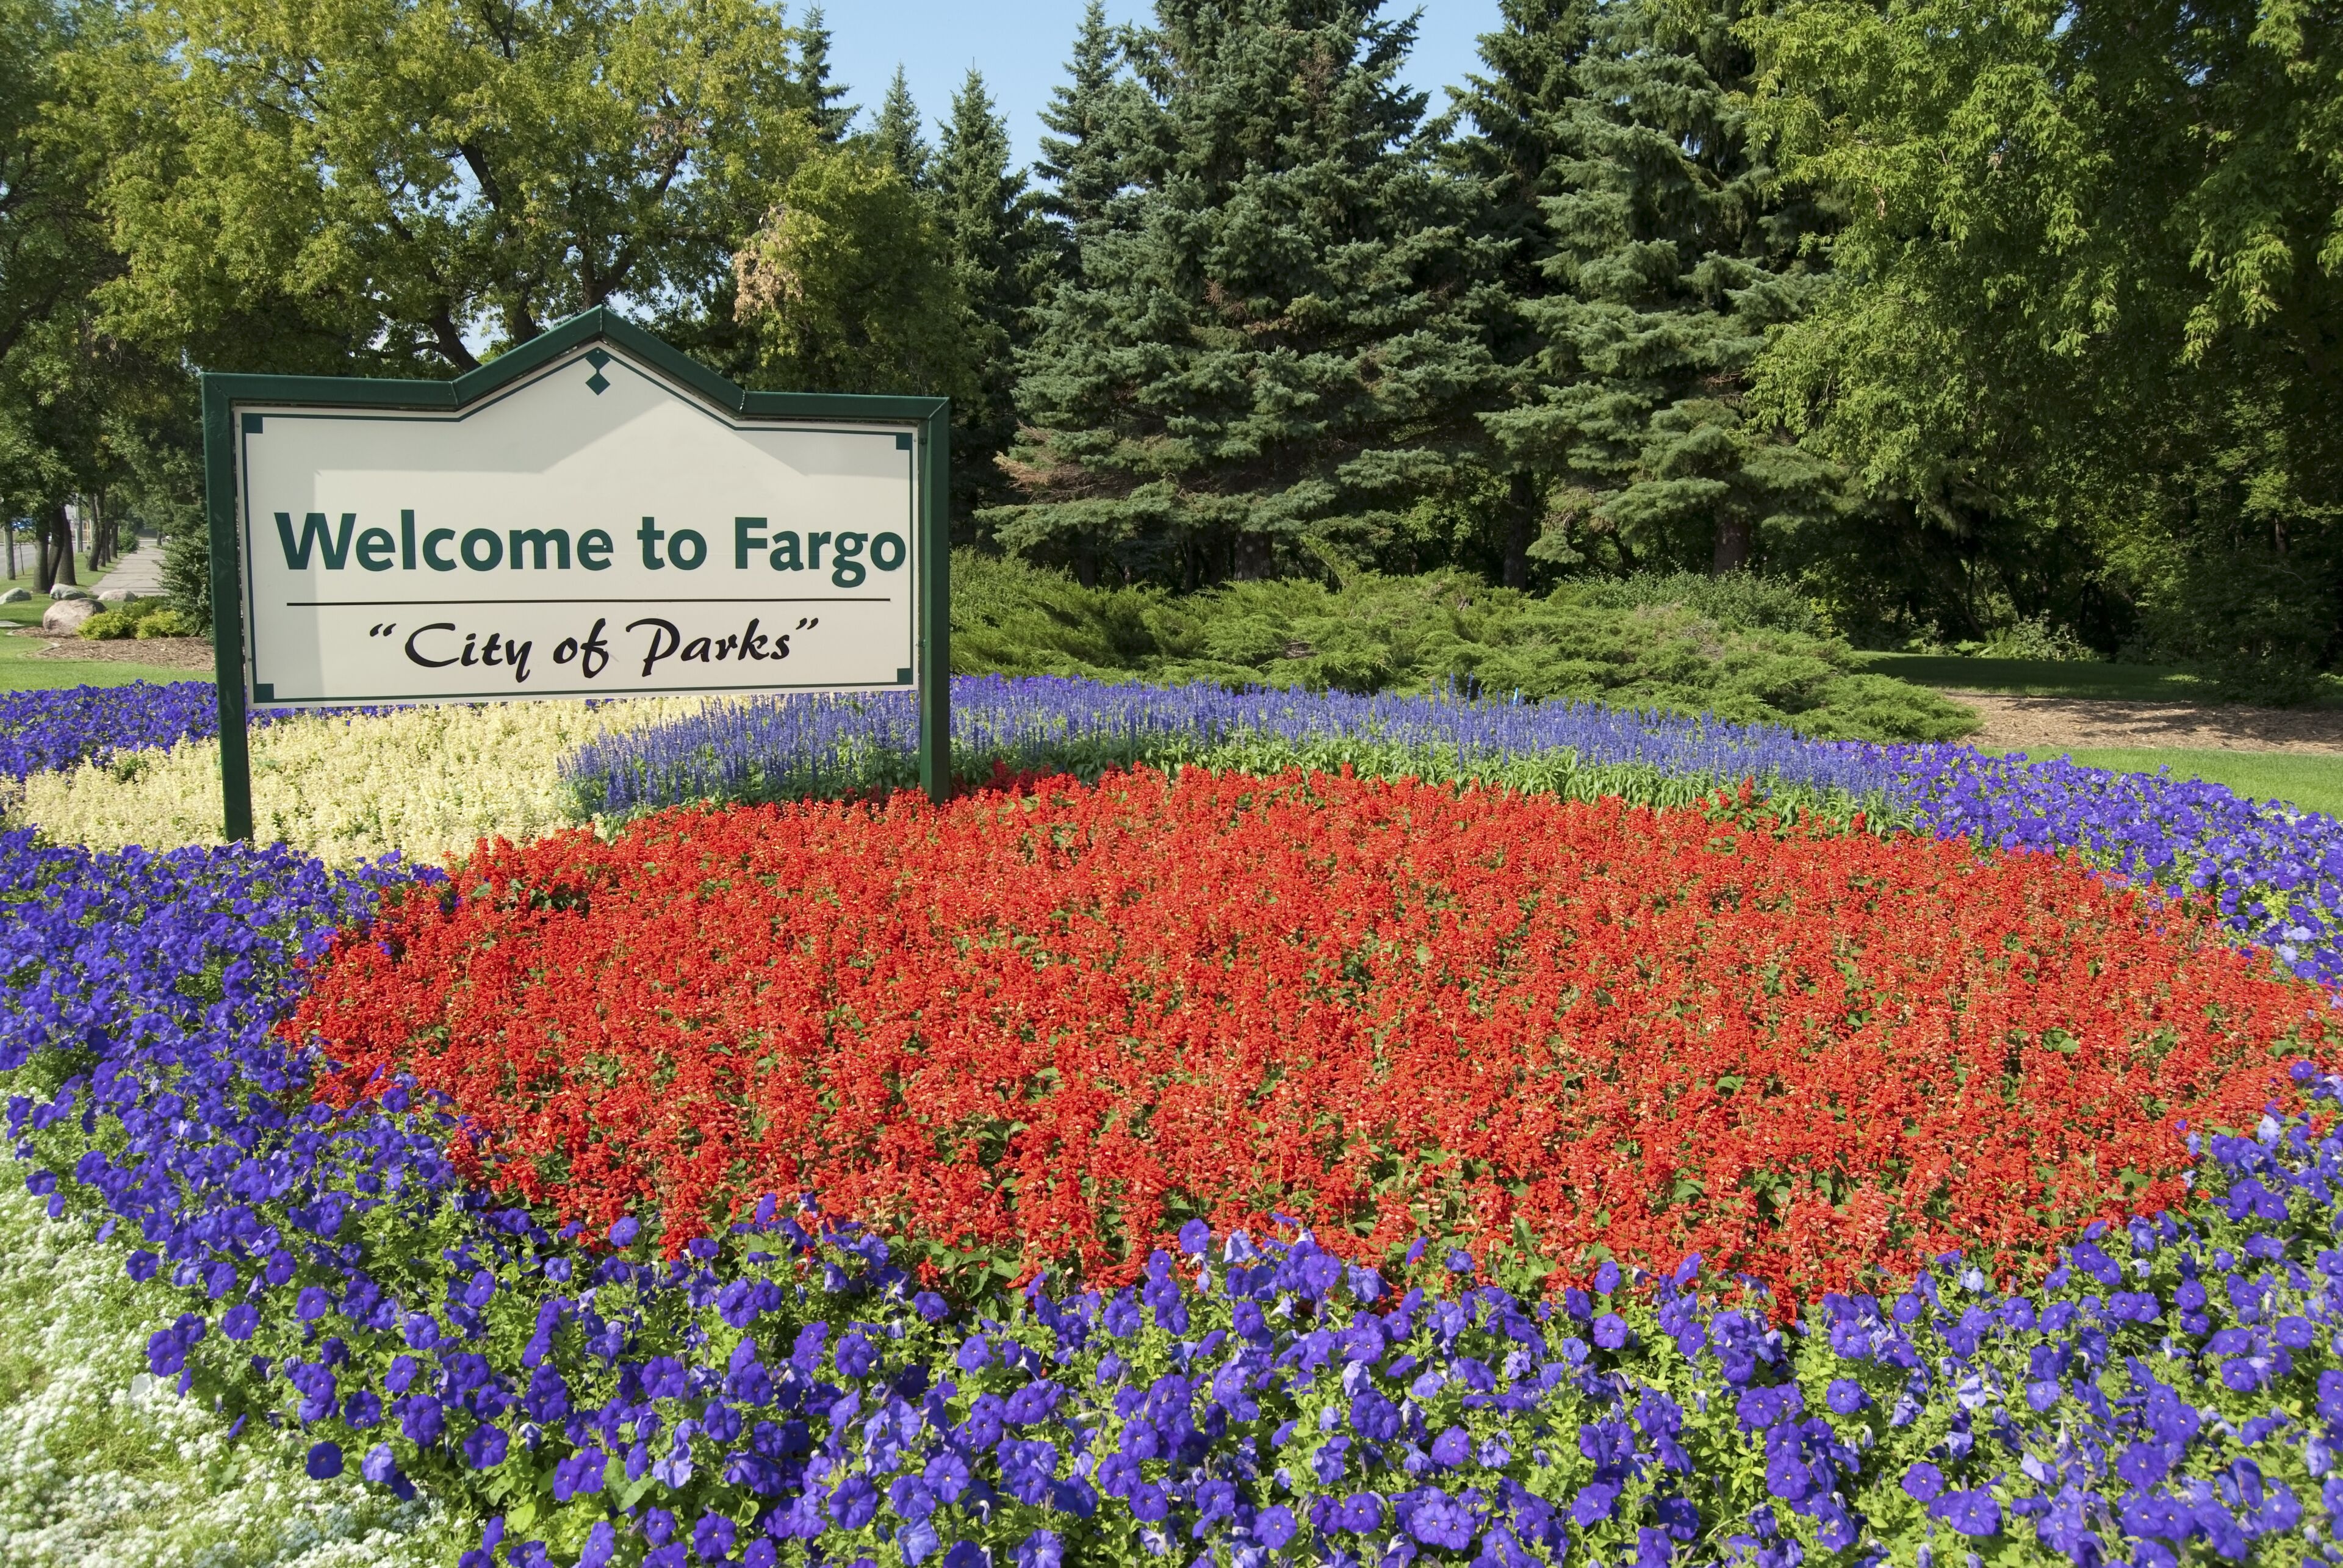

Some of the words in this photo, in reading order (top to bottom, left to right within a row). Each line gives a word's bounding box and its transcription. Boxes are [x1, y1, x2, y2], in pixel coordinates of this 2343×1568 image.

[273, 509, 614, 572] Welcome
[637, 516, 707, 572] to
[735, 517, 906, 588] Fargo
[369, 622, 533, 683] “City
[553, 617, 610, 679] of
[625, 617, 819, 677] Parks”
